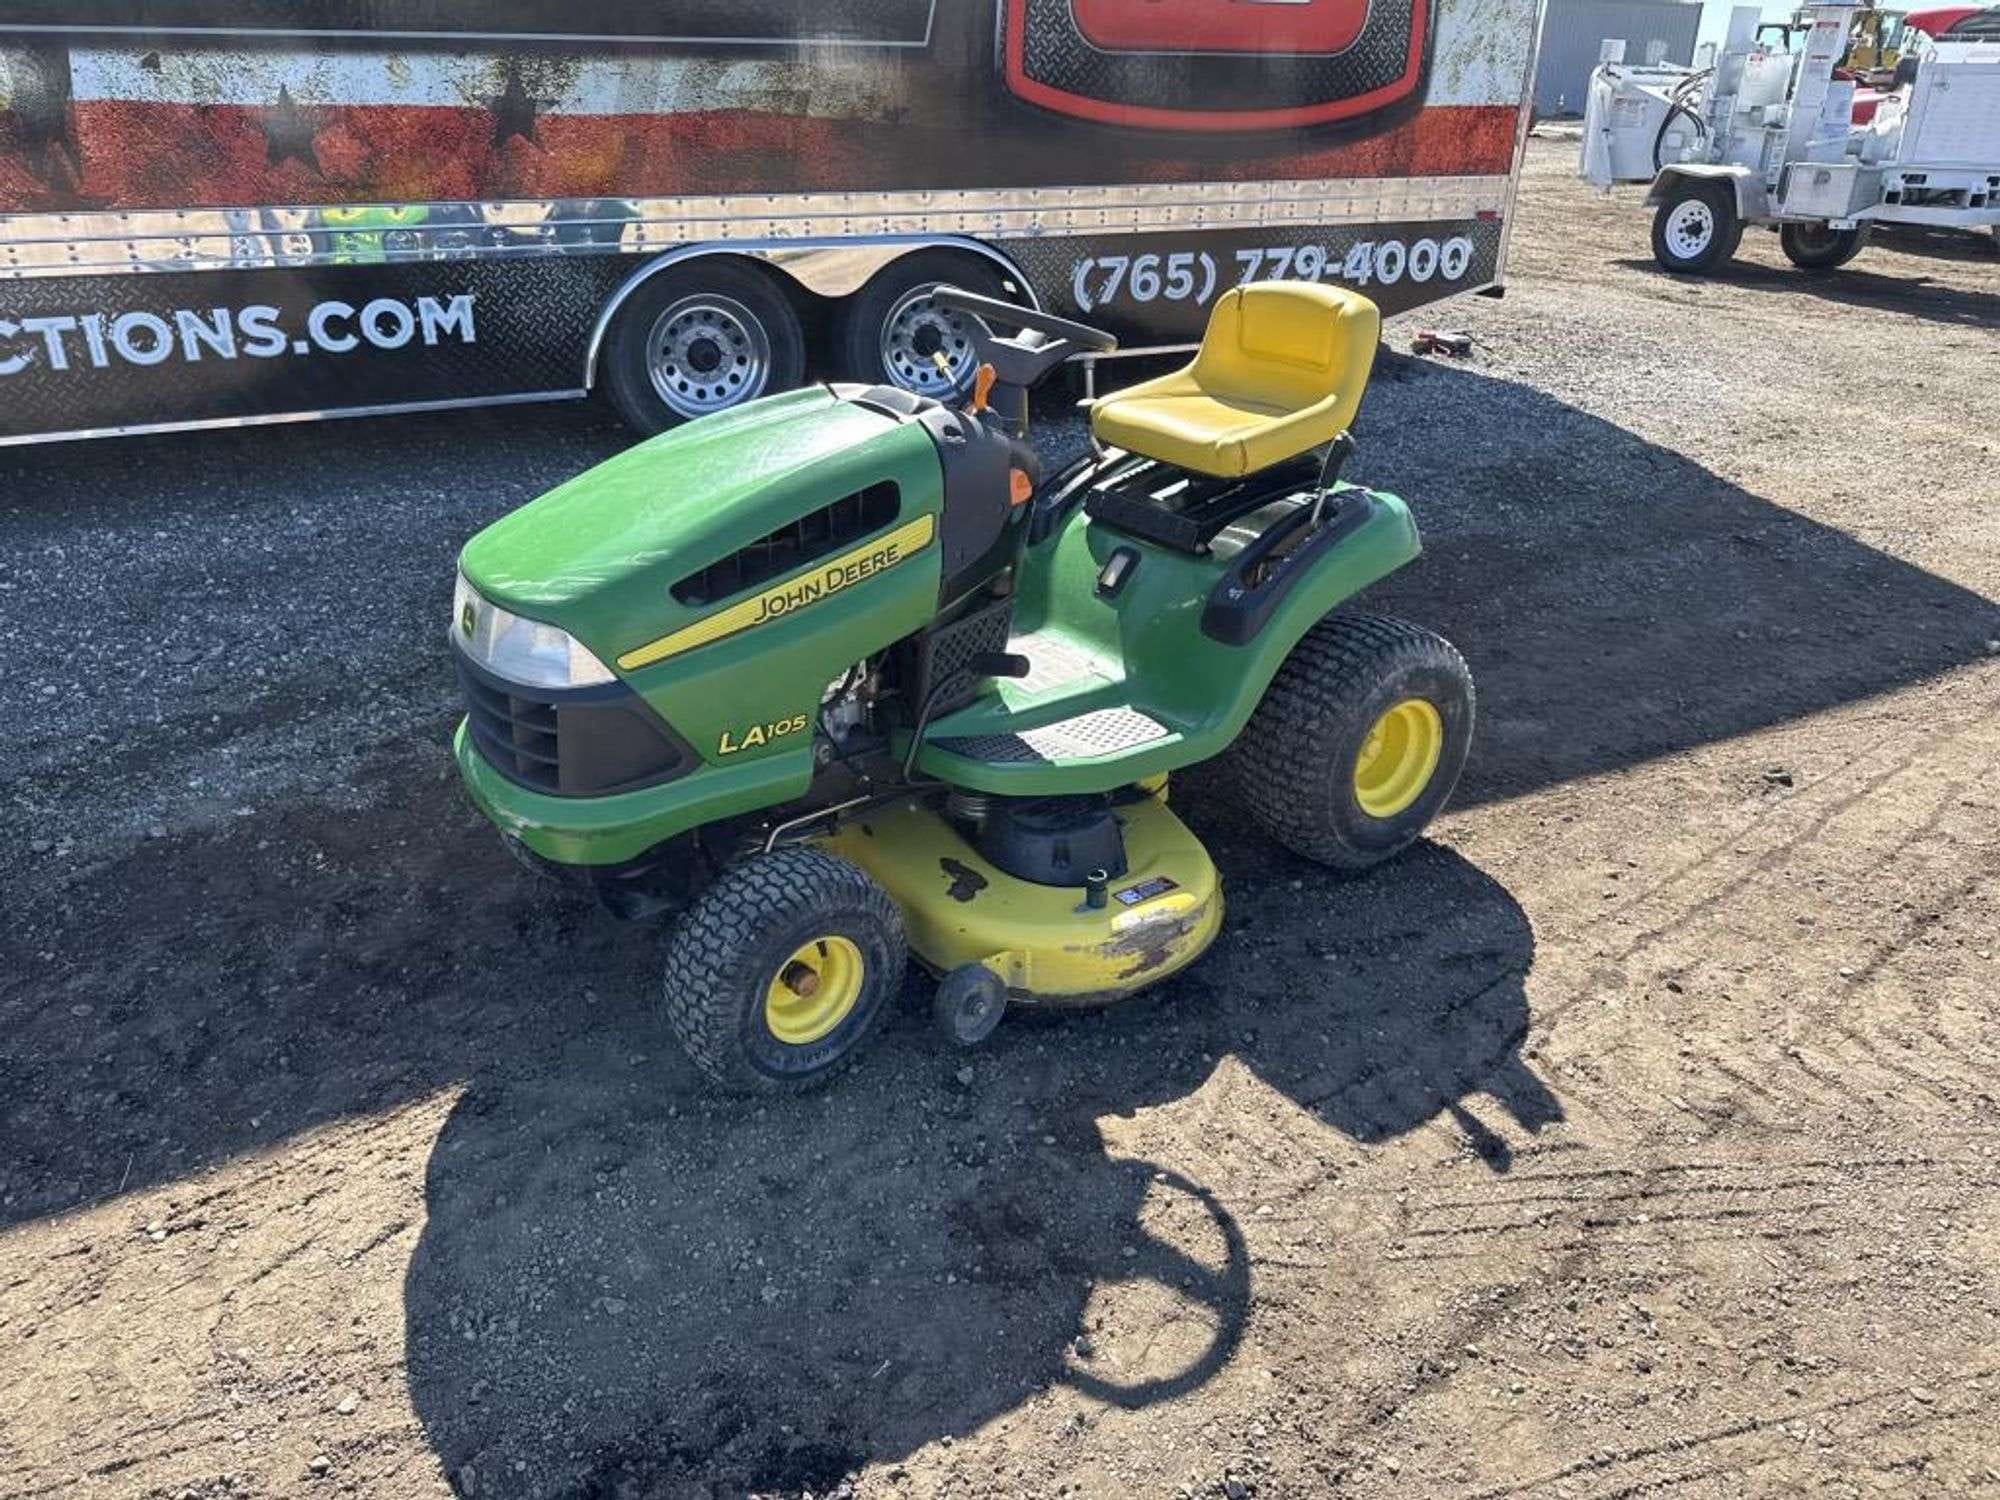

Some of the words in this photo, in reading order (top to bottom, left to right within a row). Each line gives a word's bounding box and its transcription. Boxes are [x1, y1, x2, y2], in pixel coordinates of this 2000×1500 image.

[1073, 252, 1216, 313] (765)
[1236, 236, 1473, 285] 779-4000
[753, 579, 822, 622] JOHN
[826, 543, 900, 590] DEERE
